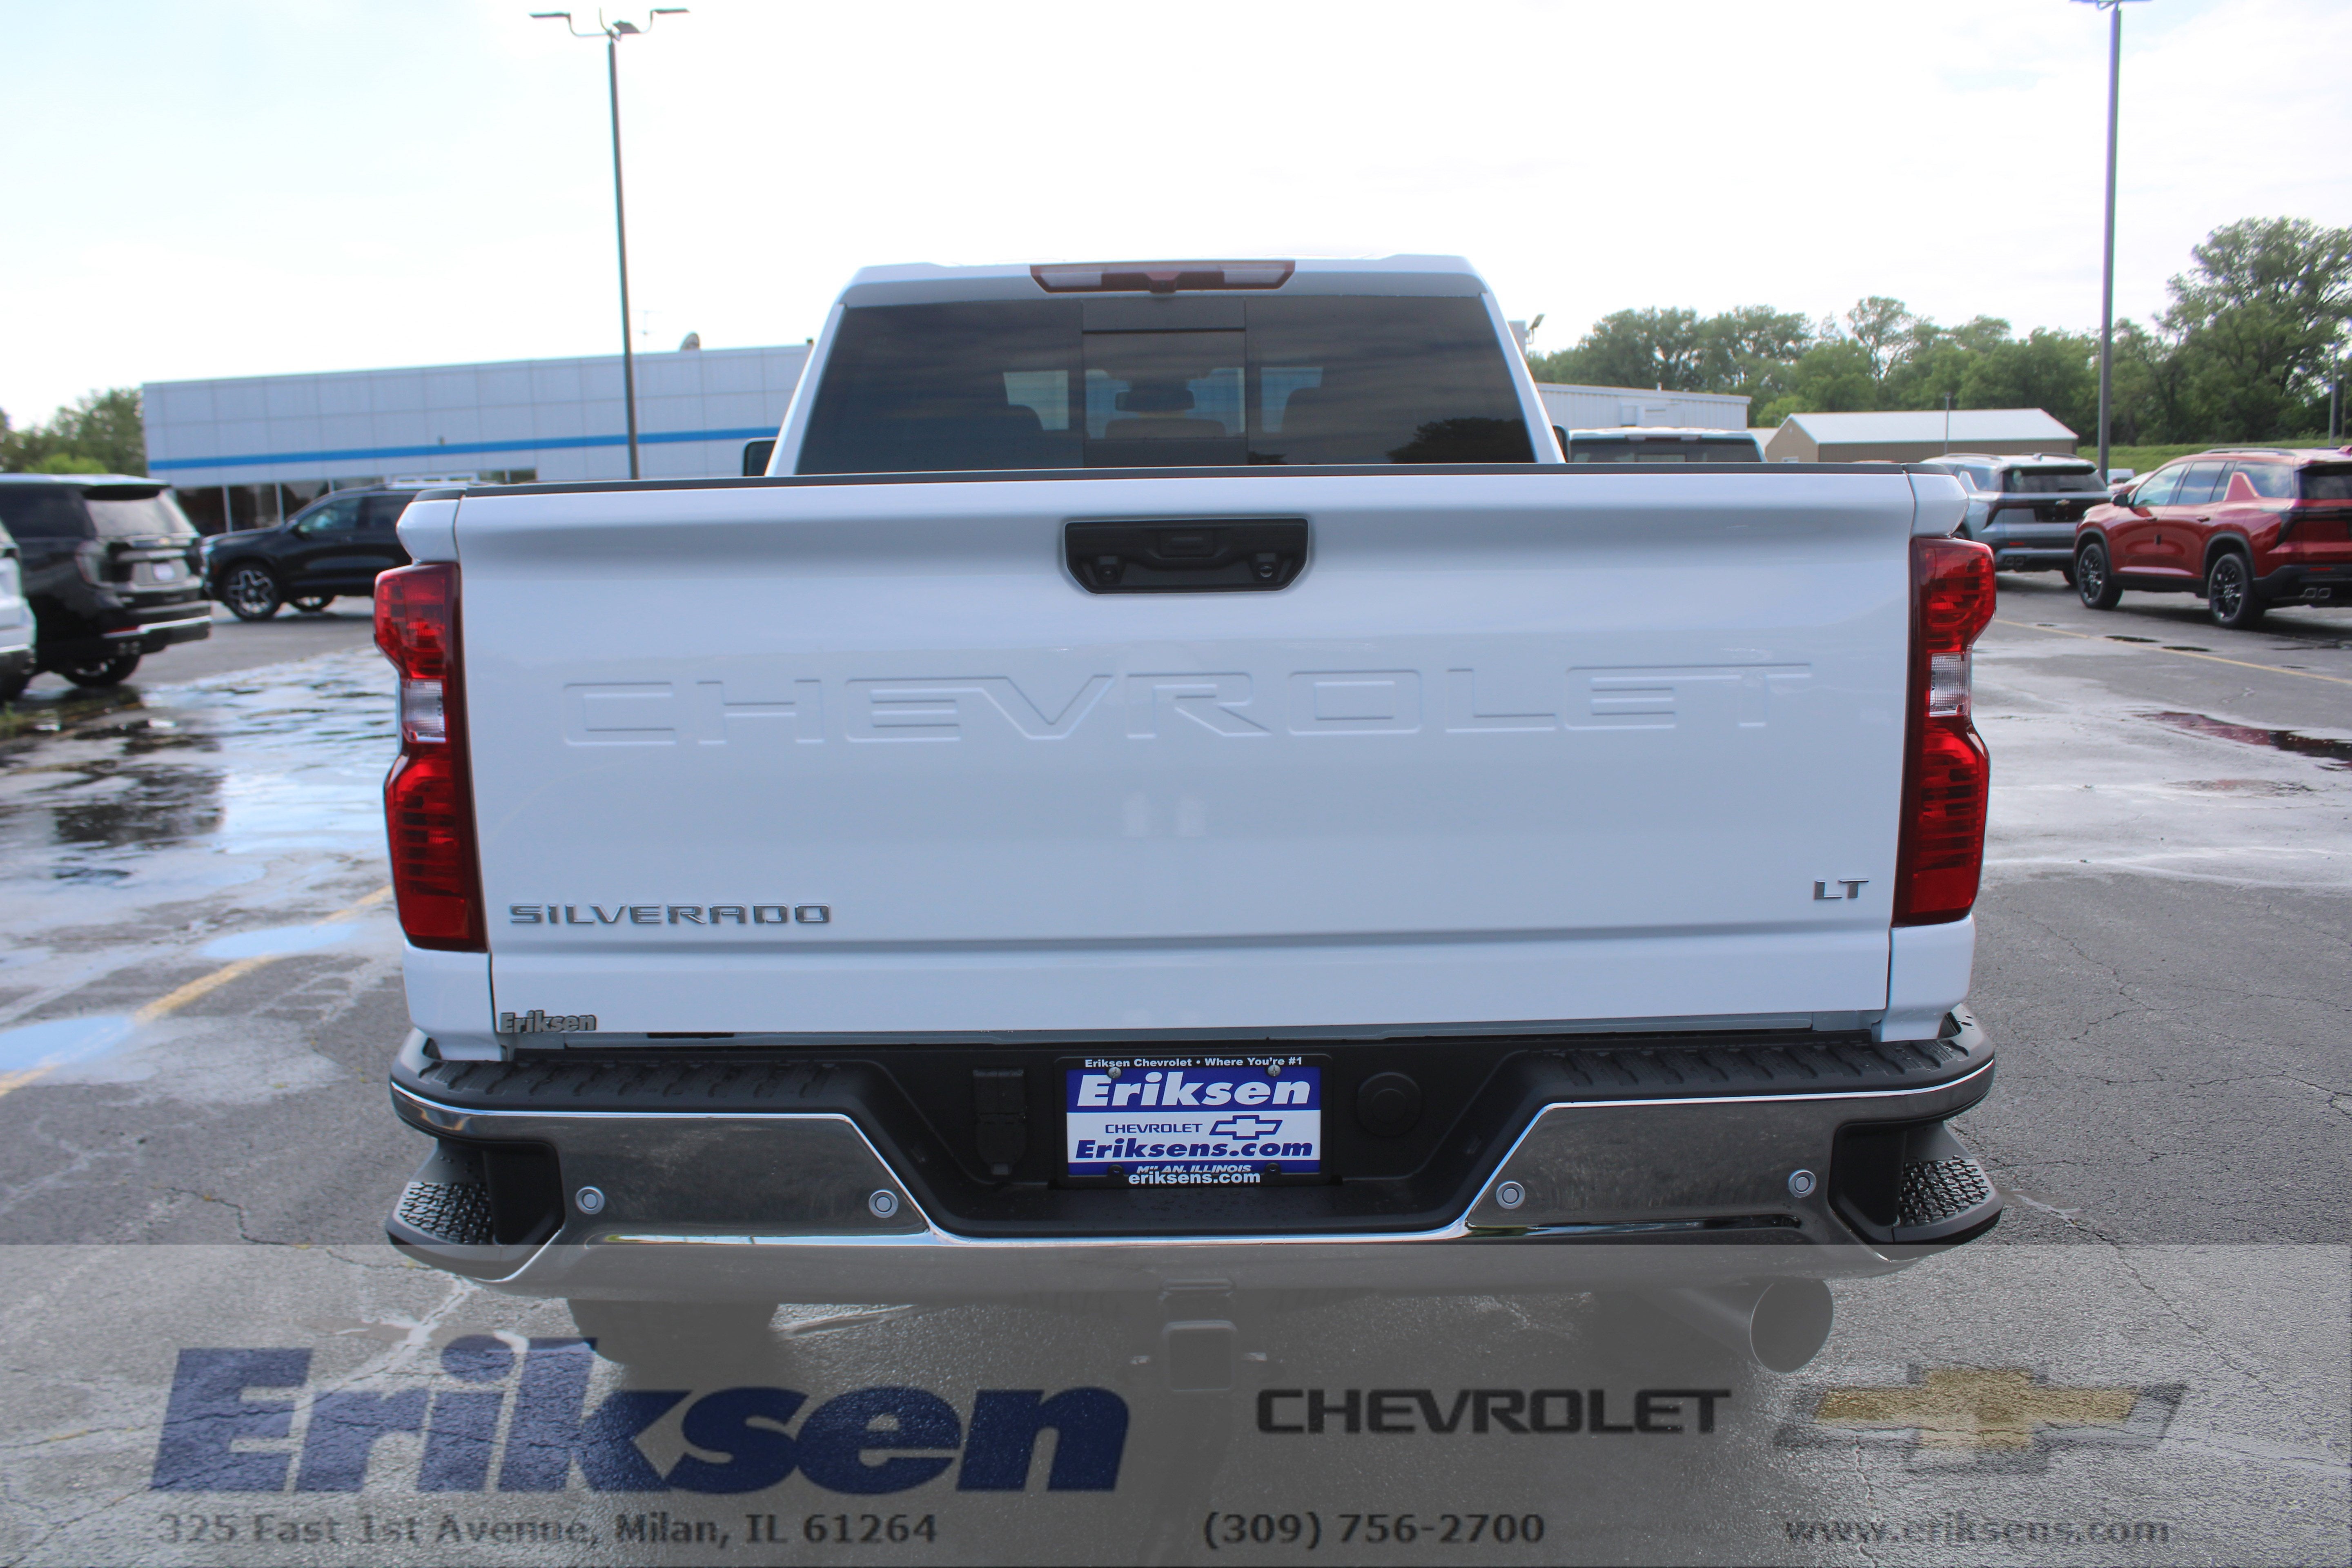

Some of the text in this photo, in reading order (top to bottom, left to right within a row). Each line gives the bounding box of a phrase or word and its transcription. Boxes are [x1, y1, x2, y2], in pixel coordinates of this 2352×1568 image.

[563, 662, 1812, 746] CHEVROLET
[1814, 878, 1869, 899] LT
[509, 903, 831, 924] SILVERADO
[500, 1010, 597, 1034] Eriksen
[1085, 1056, 1303, 1068] Eriksen Chevrolet Where You're #1
[1077, 1071, 1310, 1106] Eriksen
[1105, 1124, 1203, 1133] CHEVROLET
[1076, 1138, 1312, 1158] Eriksens.com
[1128, 1172, 1261, 1184] eriksens.com
[1190, 1165, 1252, 1173] ILLINOIS
